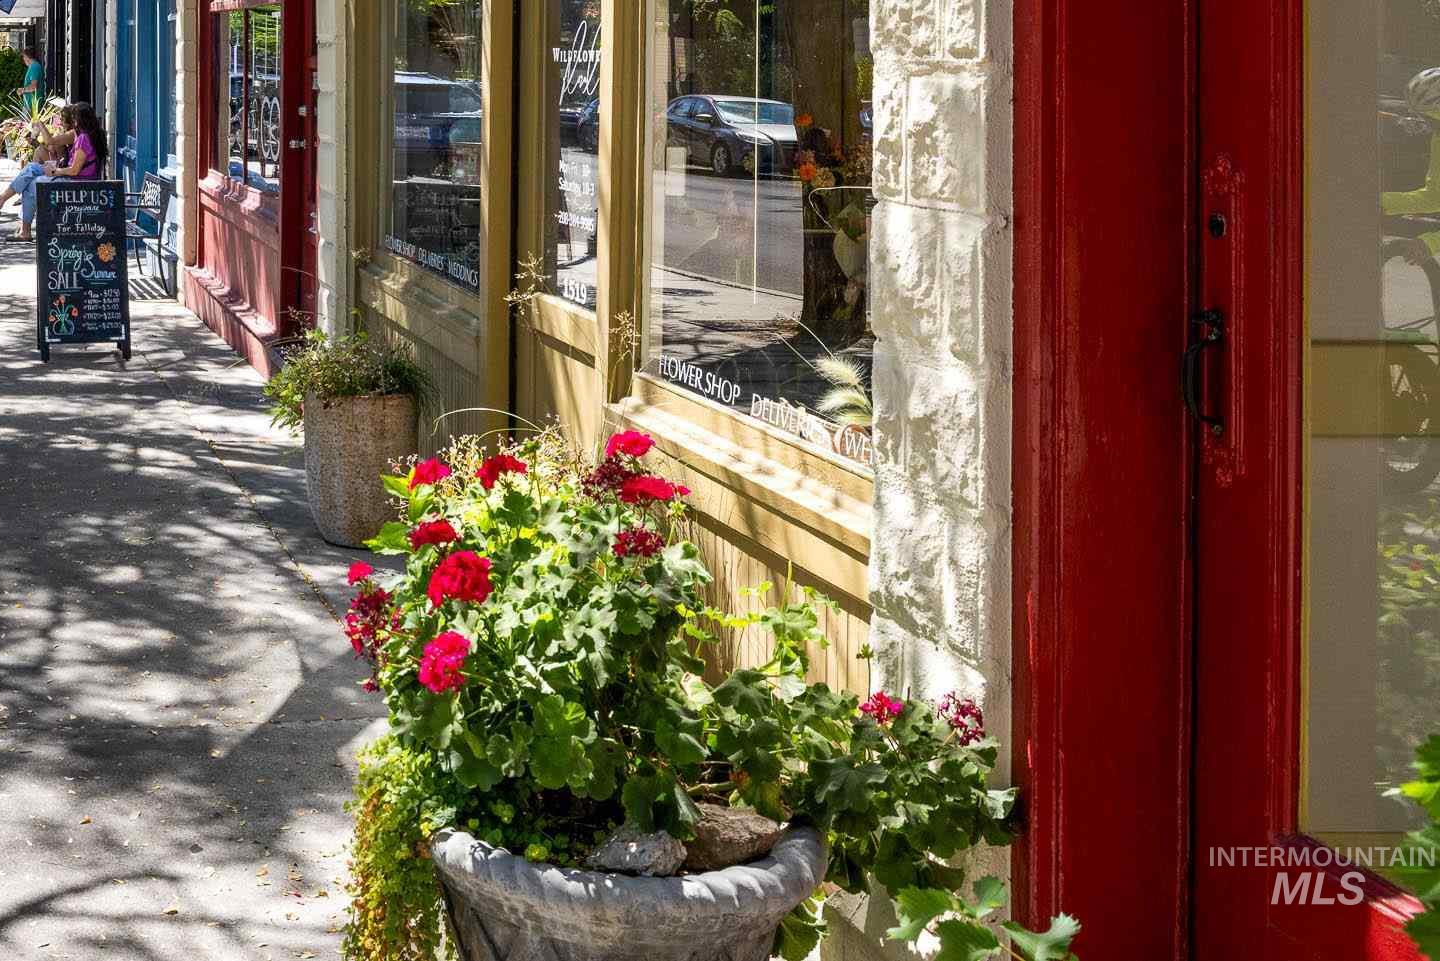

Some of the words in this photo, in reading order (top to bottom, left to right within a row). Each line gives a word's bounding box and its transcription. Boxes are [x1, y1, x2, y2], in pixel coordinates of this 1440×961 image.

[553, 48, 601, 62] WILDFLOWE
[55, 190, 87, 203] HELP
[91, 190, 109, 205] US
[56, 223, 71, 232] For
[48, 271, 83, 290] SALE
[562, 279, 587, 304] 1519
[659, 354, 703, 390] FLOWER
[705, 372, 740, 405] SHOP
